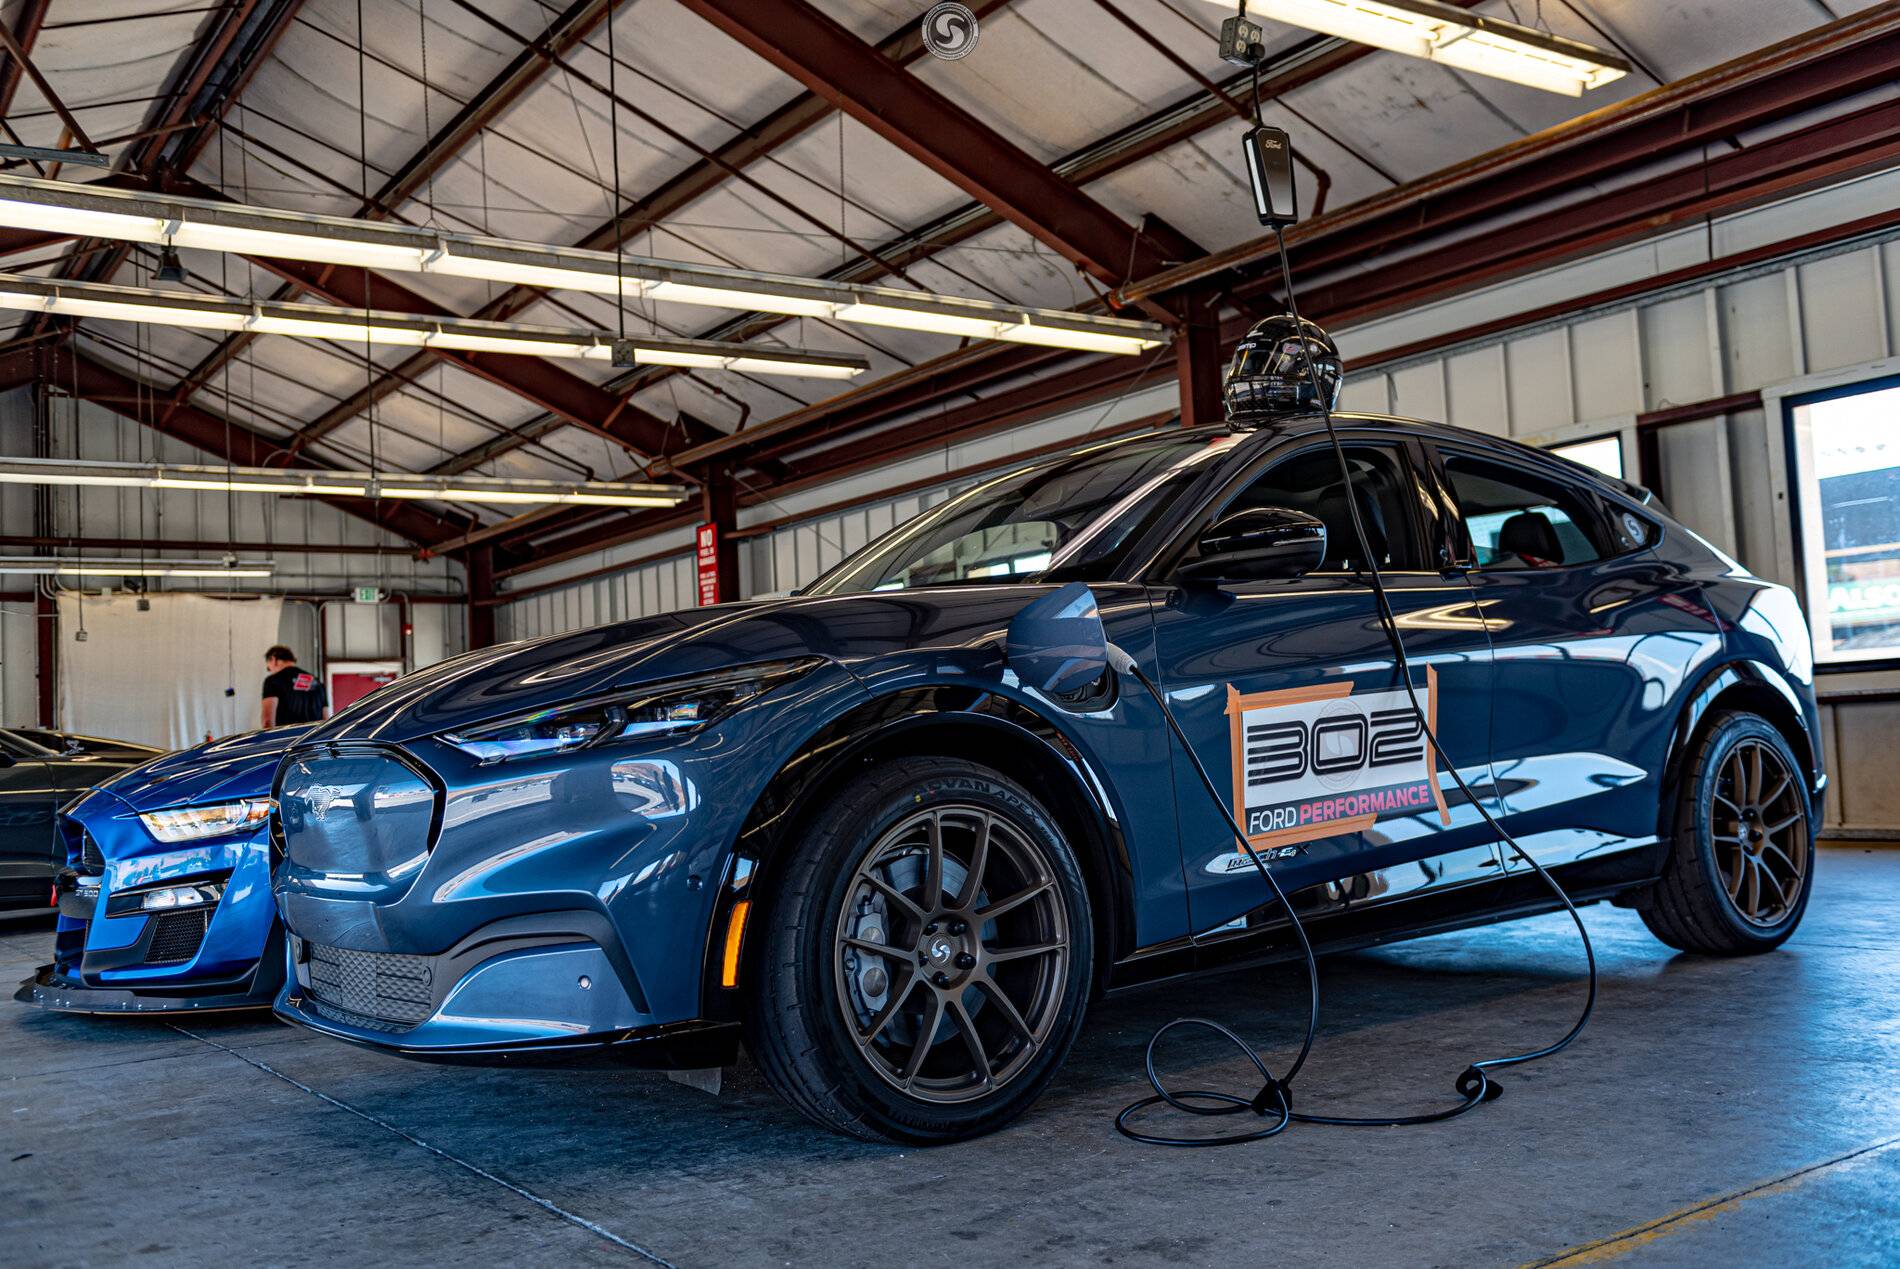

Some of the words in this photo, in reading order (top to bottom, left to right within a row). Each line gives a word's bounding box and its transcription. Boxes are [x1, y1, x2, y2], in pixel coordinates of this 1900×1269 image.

[1247, 708, 1424, 787] 302
[1249, 806, 1297, 834] FORD
[1300, 785, 1430, 825] PERFORMANCE
